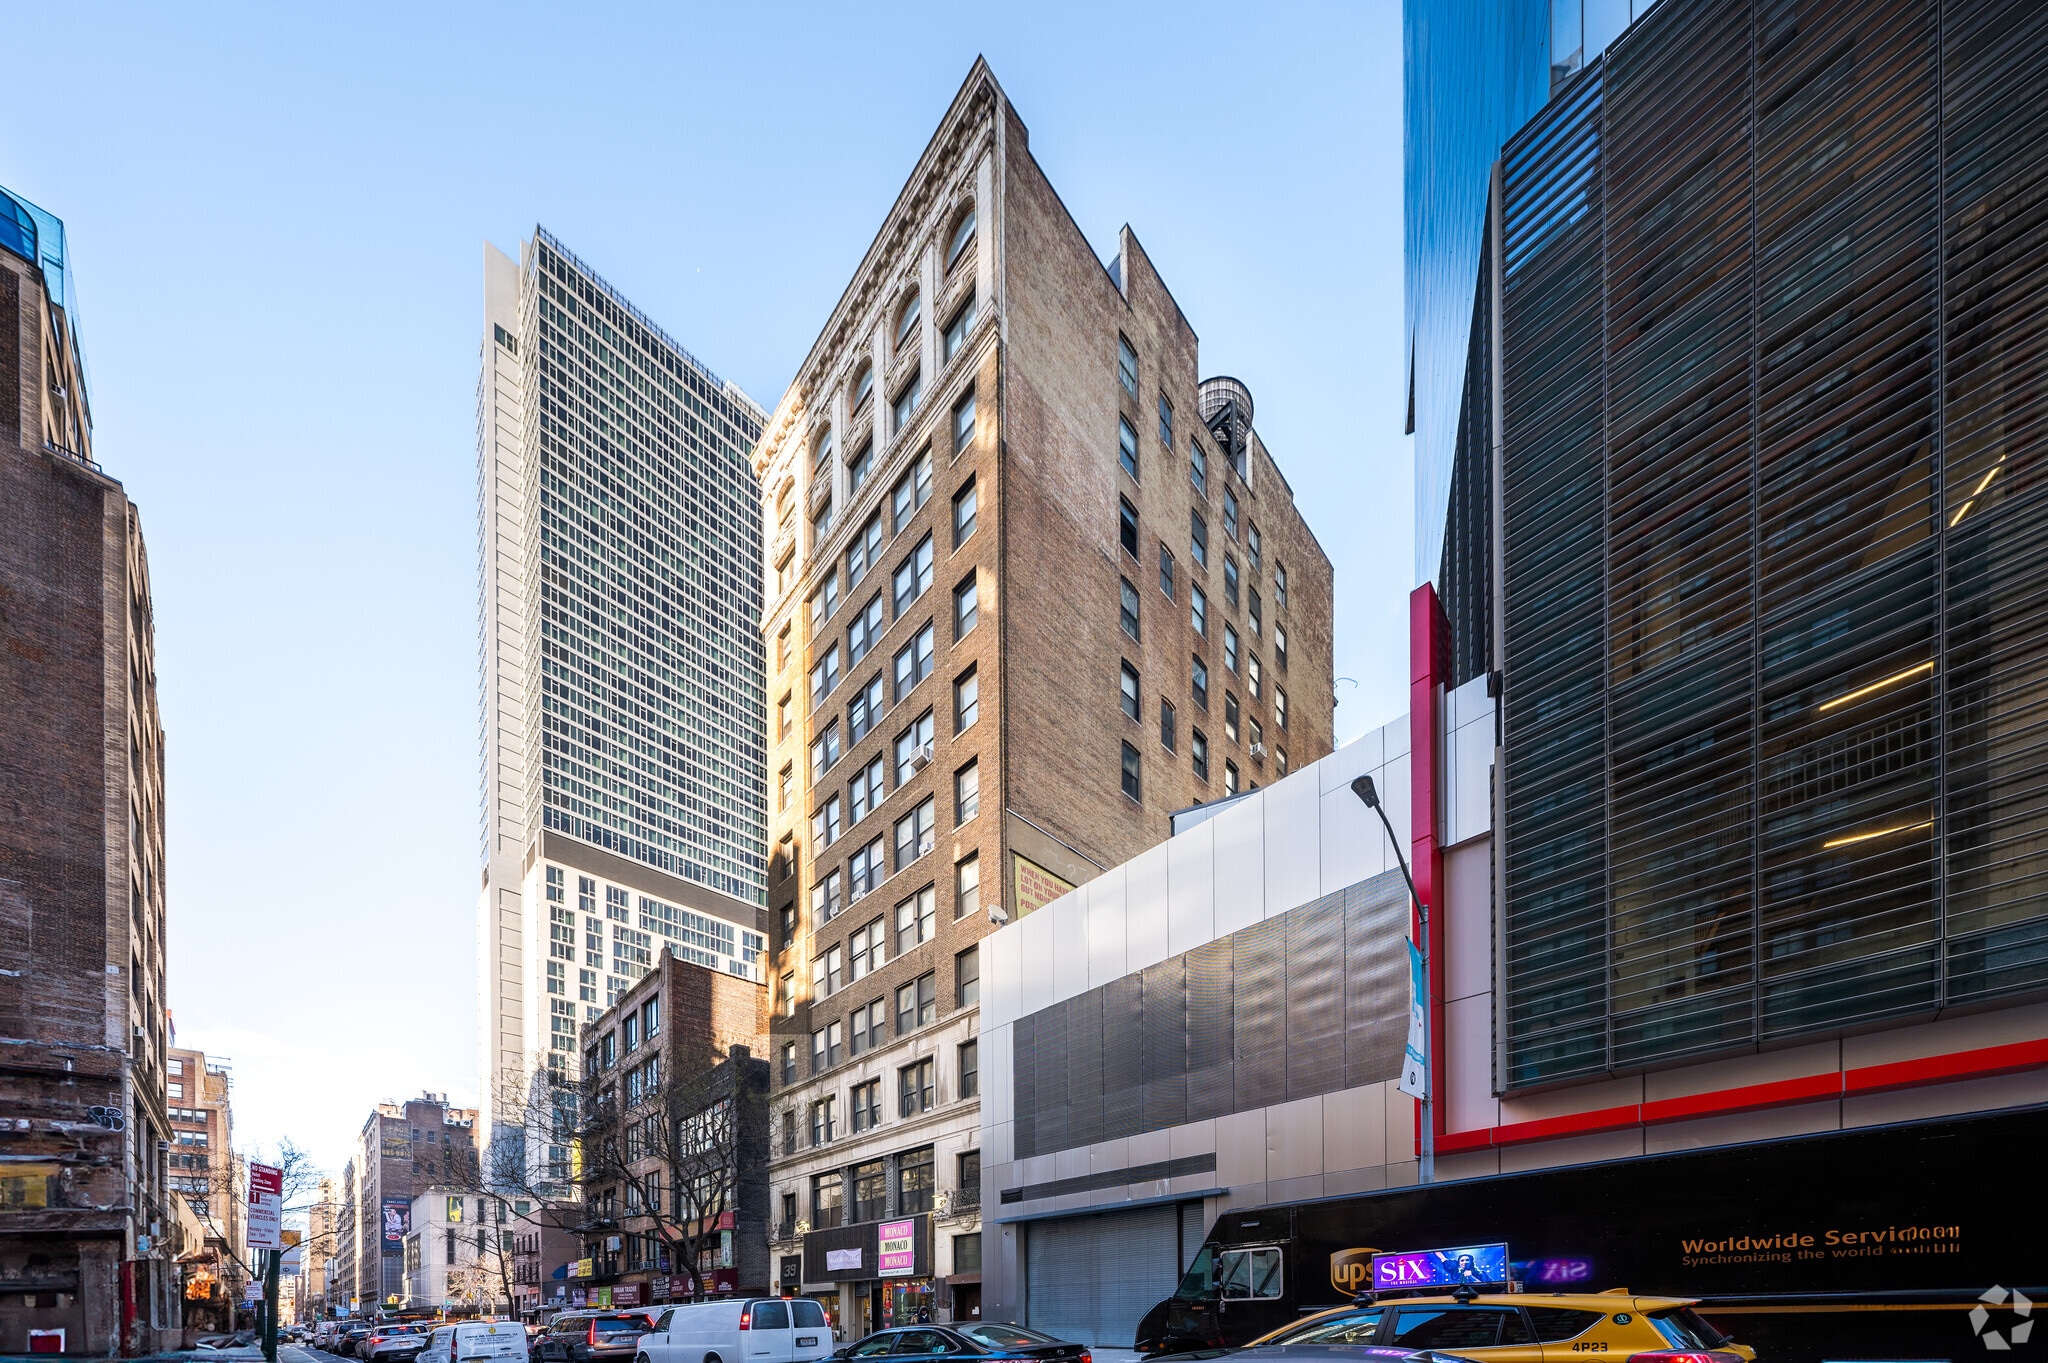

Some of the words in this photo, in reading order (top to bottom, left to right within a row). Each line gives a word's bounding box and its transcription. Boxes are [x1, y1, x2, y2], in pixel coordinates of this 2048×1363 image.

[1021, 864, 1039, 880] WHEN
[1041, 876, 1053, 888] YOU
[1021, 874, 1032, 886] LOT
[1034, 881, 1042, 892] ON
[1021, 884, 1033, 895] BUT
[258, 1166, 278, 1176] STANDING
[250, 1207, 275, 1216] COMMERCIAL
[885, 1225, 908, 1239] MONACO
[885, 1239, 908, 1252] MONACO
[1681, 1233, 1814, 1254] Worldwide
[885, 1255, 908, 1267] MONACO
[1682, 1251, 1792, 1267] Synchronizing
[1798, 1249, 1825, 1260] the
[1832, 1245, 1883, 1258] world
[784, 1264, 796, 1277] 39
[1572, 1342, 1608, 1352] 4P23
